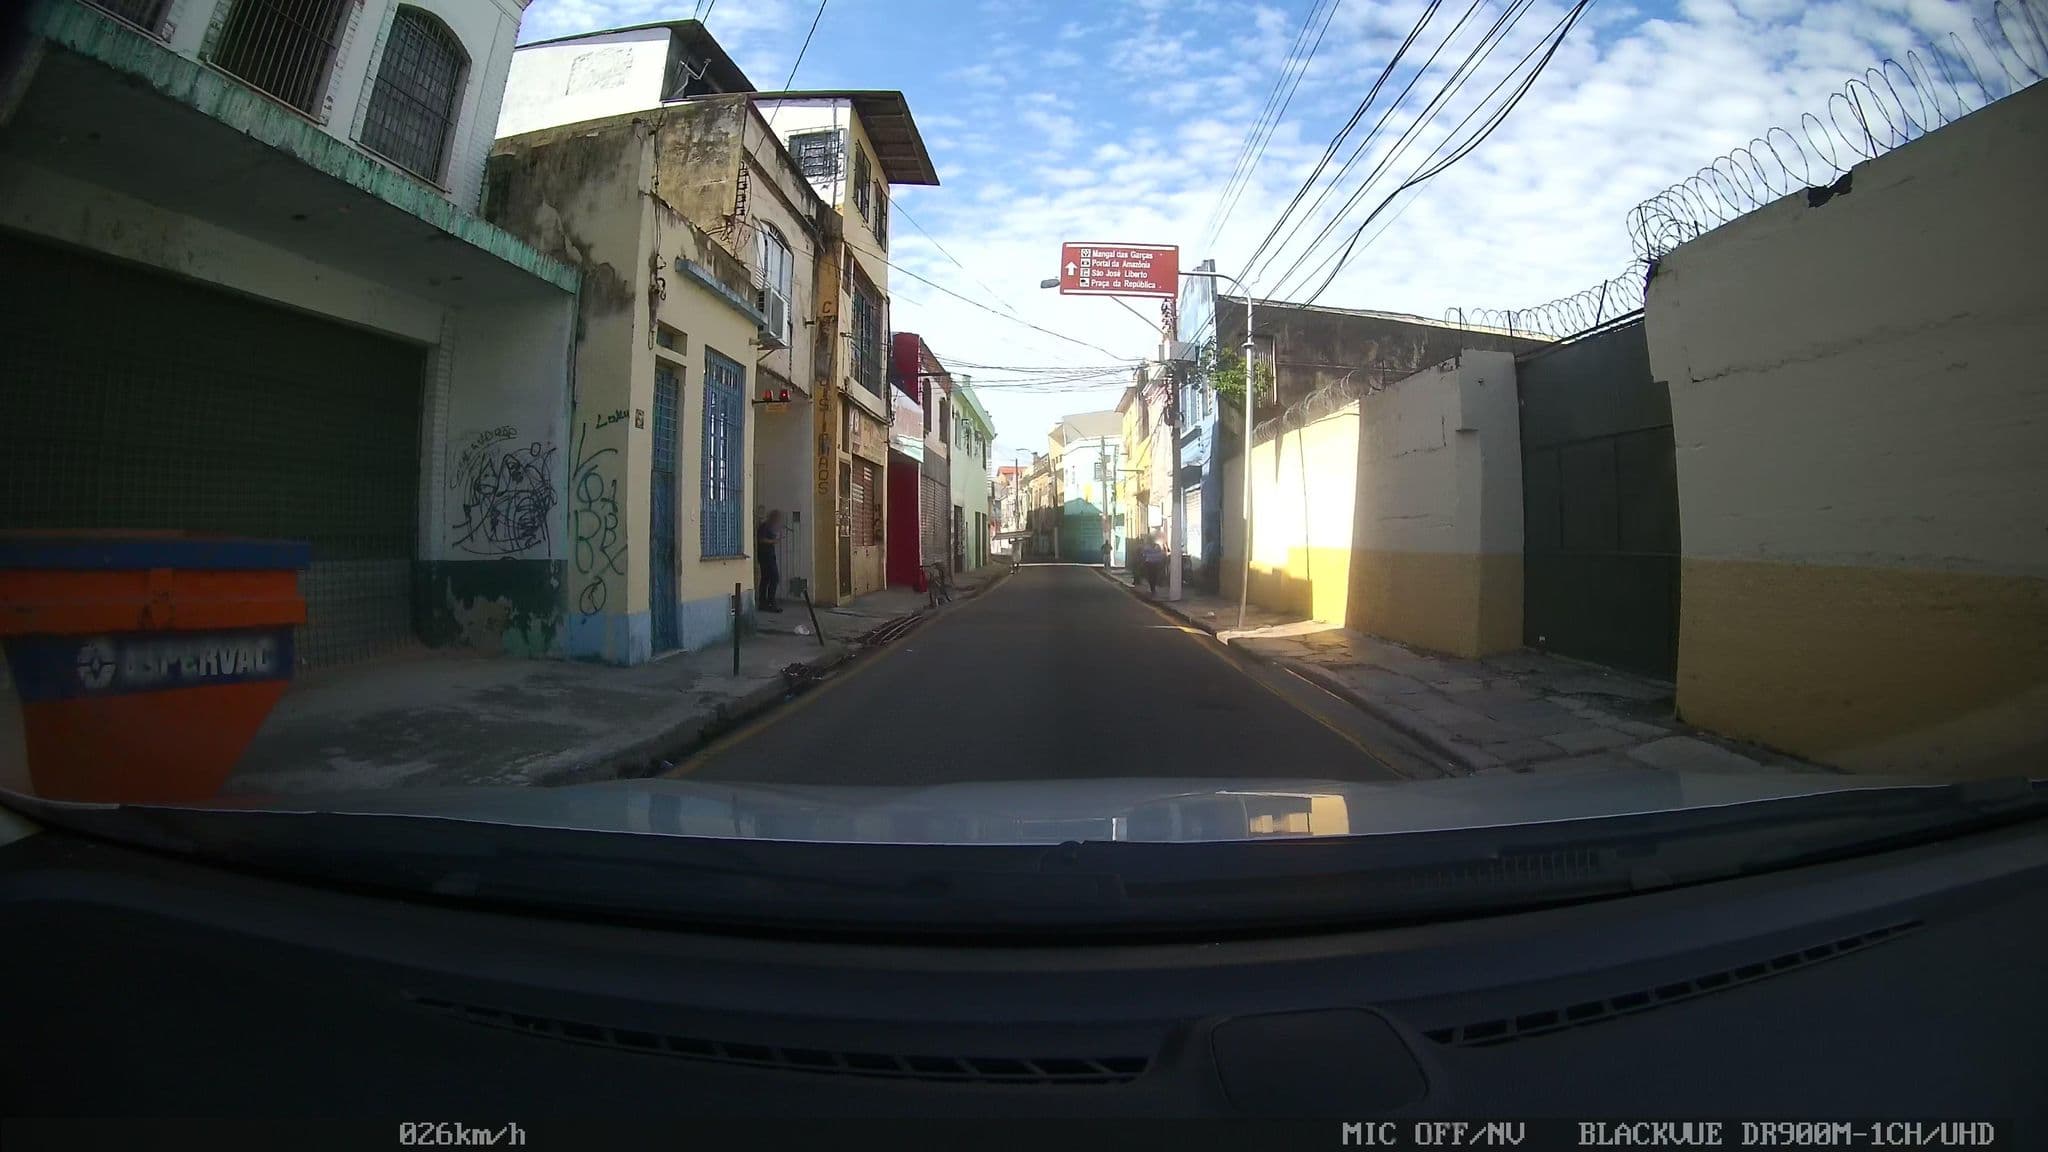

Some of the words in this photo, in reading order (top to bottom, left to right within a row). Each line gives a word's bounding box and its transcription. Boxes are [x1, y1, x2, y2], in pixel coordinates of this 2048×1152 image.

[1092, 249, 1115, 259] Mangal
[1130, 251, 1153, 260] Garças
[1091, 259, 1111, 267] Portal
[1122, 260, 1151, 268] Amazônia
[1091, 269, 1104, 277] São
[1124, 270, 1148, 278] Liberto
[1091, 279, 1110, 288] Praça
[1113, 279, 1121, 287] da
[1124, 280, 1156, 289] República
